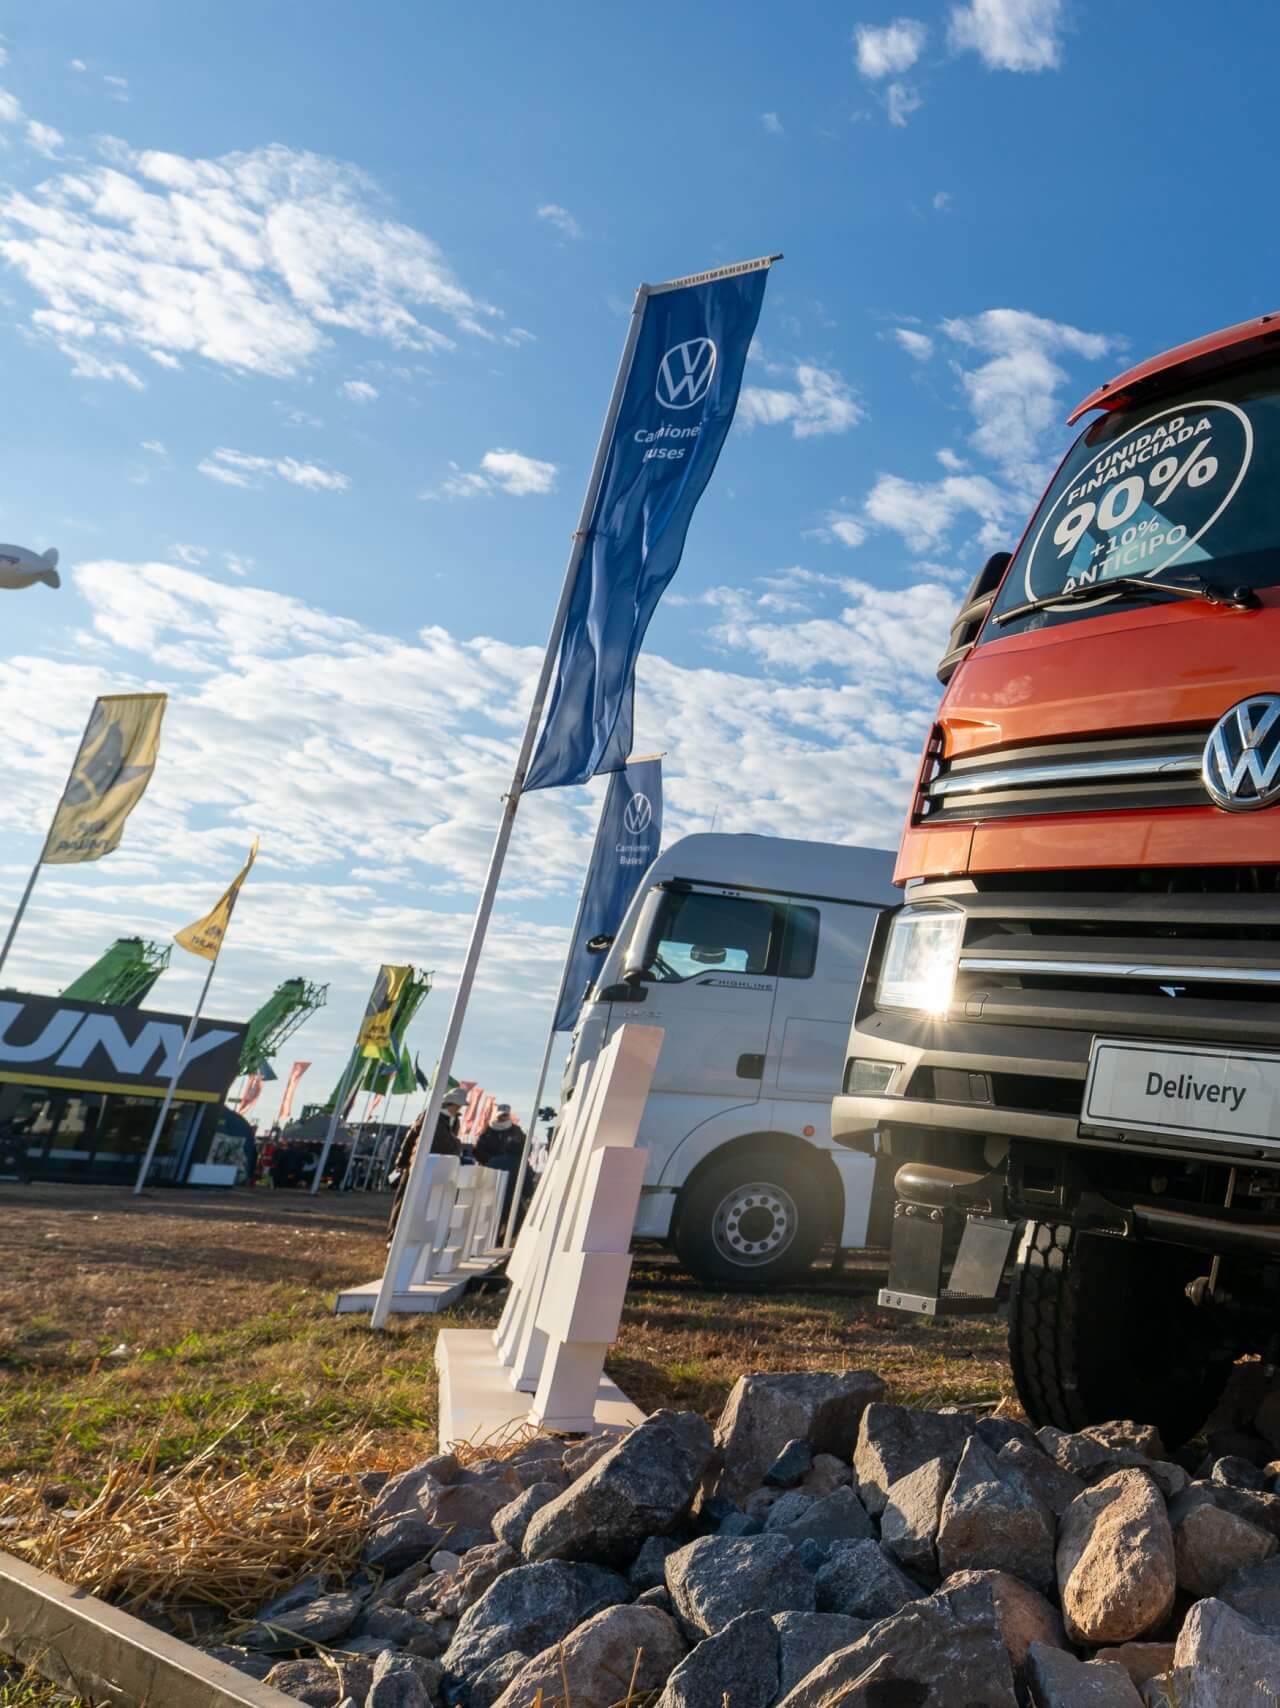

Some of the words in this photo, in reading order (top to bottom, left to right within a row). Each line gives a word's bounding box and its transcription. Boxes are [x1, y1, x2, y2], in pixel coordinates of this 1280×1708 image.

[1067, 418, 1212, 505] FINANCIADA
[1095, 416, 1185, 474] UNIDAD
[1054, 437, 1218, 559] 90%
[1062, 525, 1187, 595] ANTICIPO
[1090, 515, 1159, 557] +10%
[0, 1001, 241, 1079] UNY
[1146, 1071, 1246, 1112] Delivery
